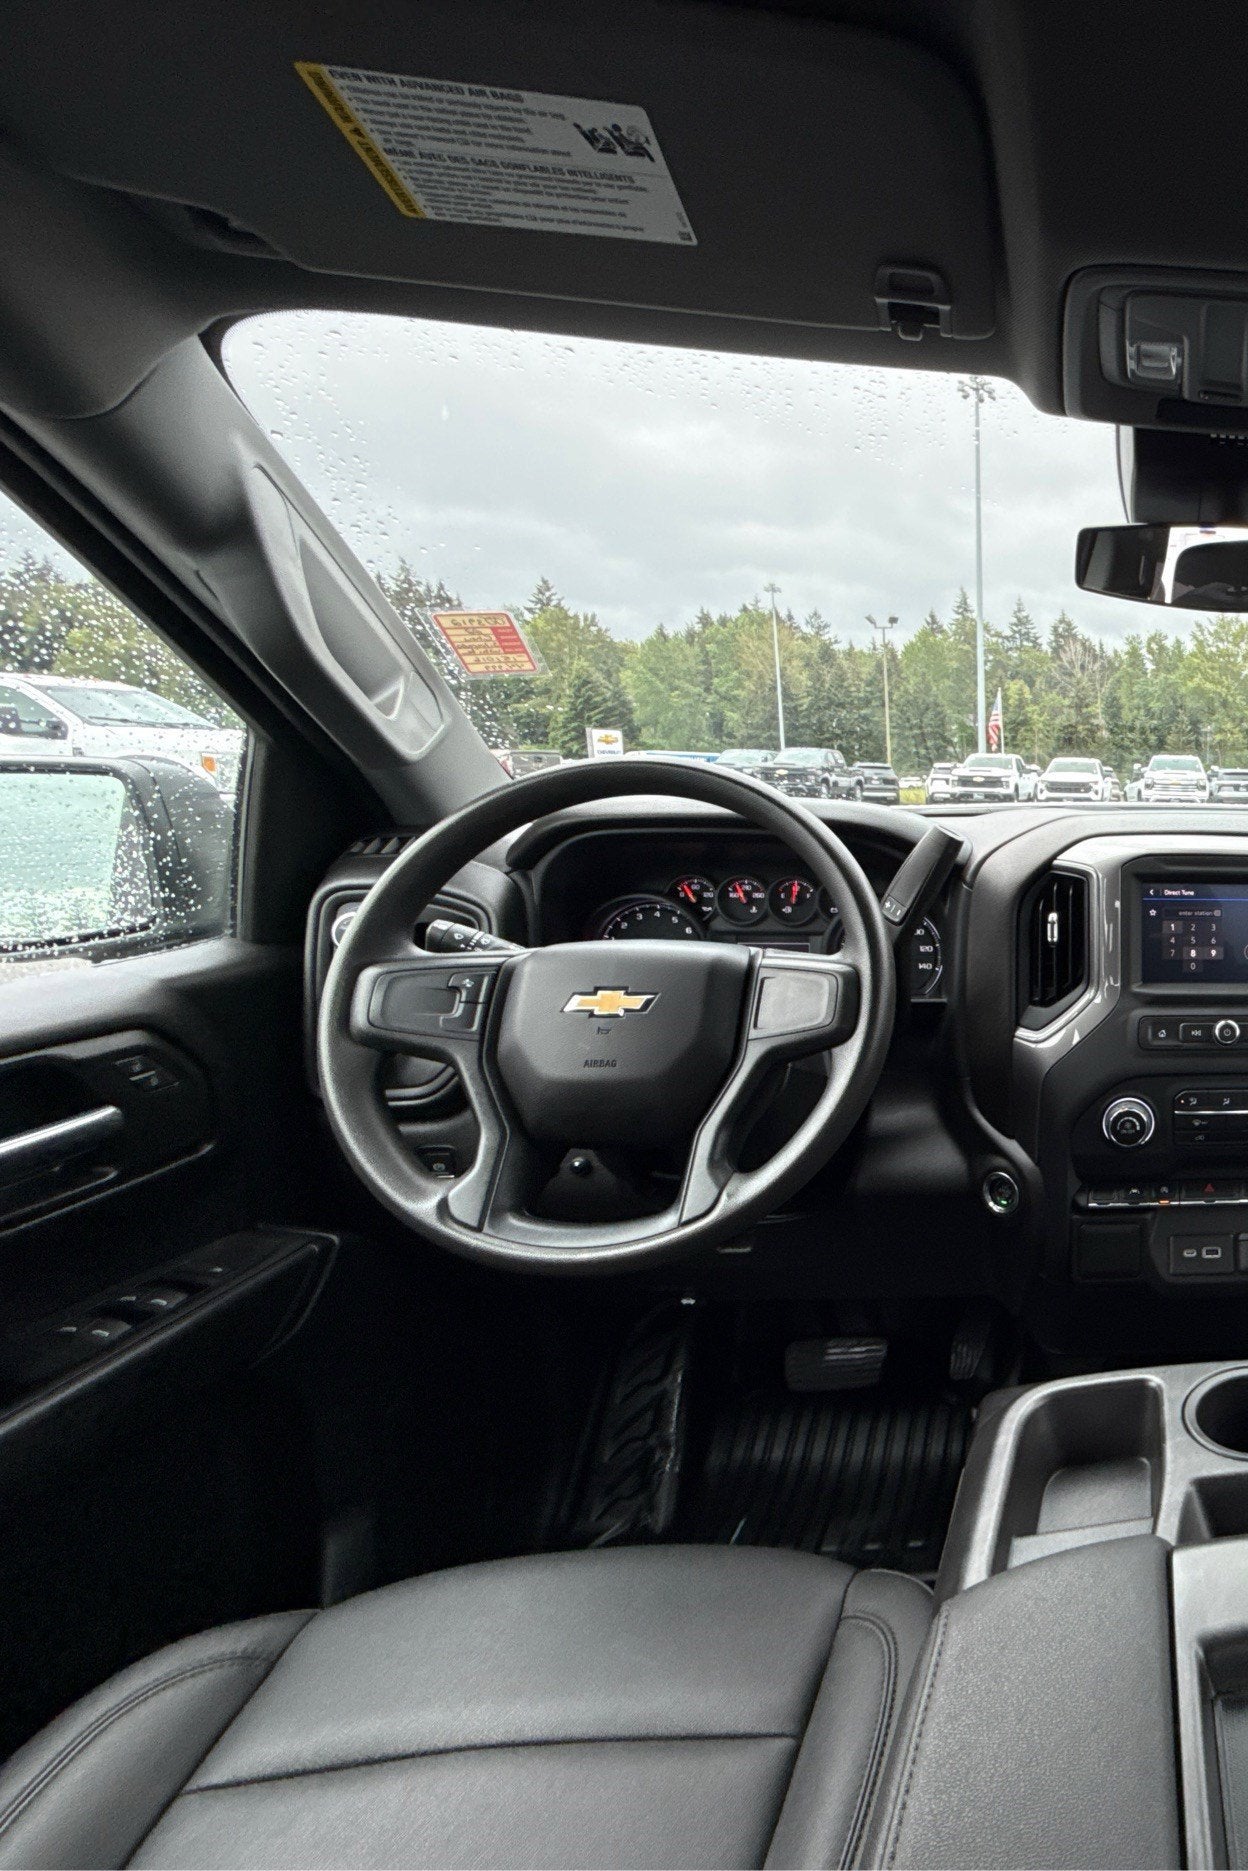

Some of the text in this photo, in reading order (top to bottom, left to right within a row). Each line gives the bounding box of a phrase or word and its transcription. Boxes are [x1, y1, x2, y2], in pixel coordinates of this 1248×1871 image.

[326, 68, 526, 103] EVEN WITH ADVANCED AIR BAGS
[636, 912, 643, 920] 3
[653, 909, 660, 917] 4
[671, 915, 678, 923] 5
[685, 926, 692, 934] 6
[1170, 923, 1175, 931] 1
[1190, 923, 1196, 931] 2
[1211, 923, 1216, 931] 3
[1170, 936, 1175, 944] 4
[1190, 936, 1196, 944] 5
[1211, 936, 1216, 944] 6
[1170, 949, 1175, 957] 7
[1190, 949, 1196, 957] 8
[1211, 949, 1216, 957] 9
[1190, 962, 1196, 970] 0
[583, 1059, 617, 1068] AIRBAG
